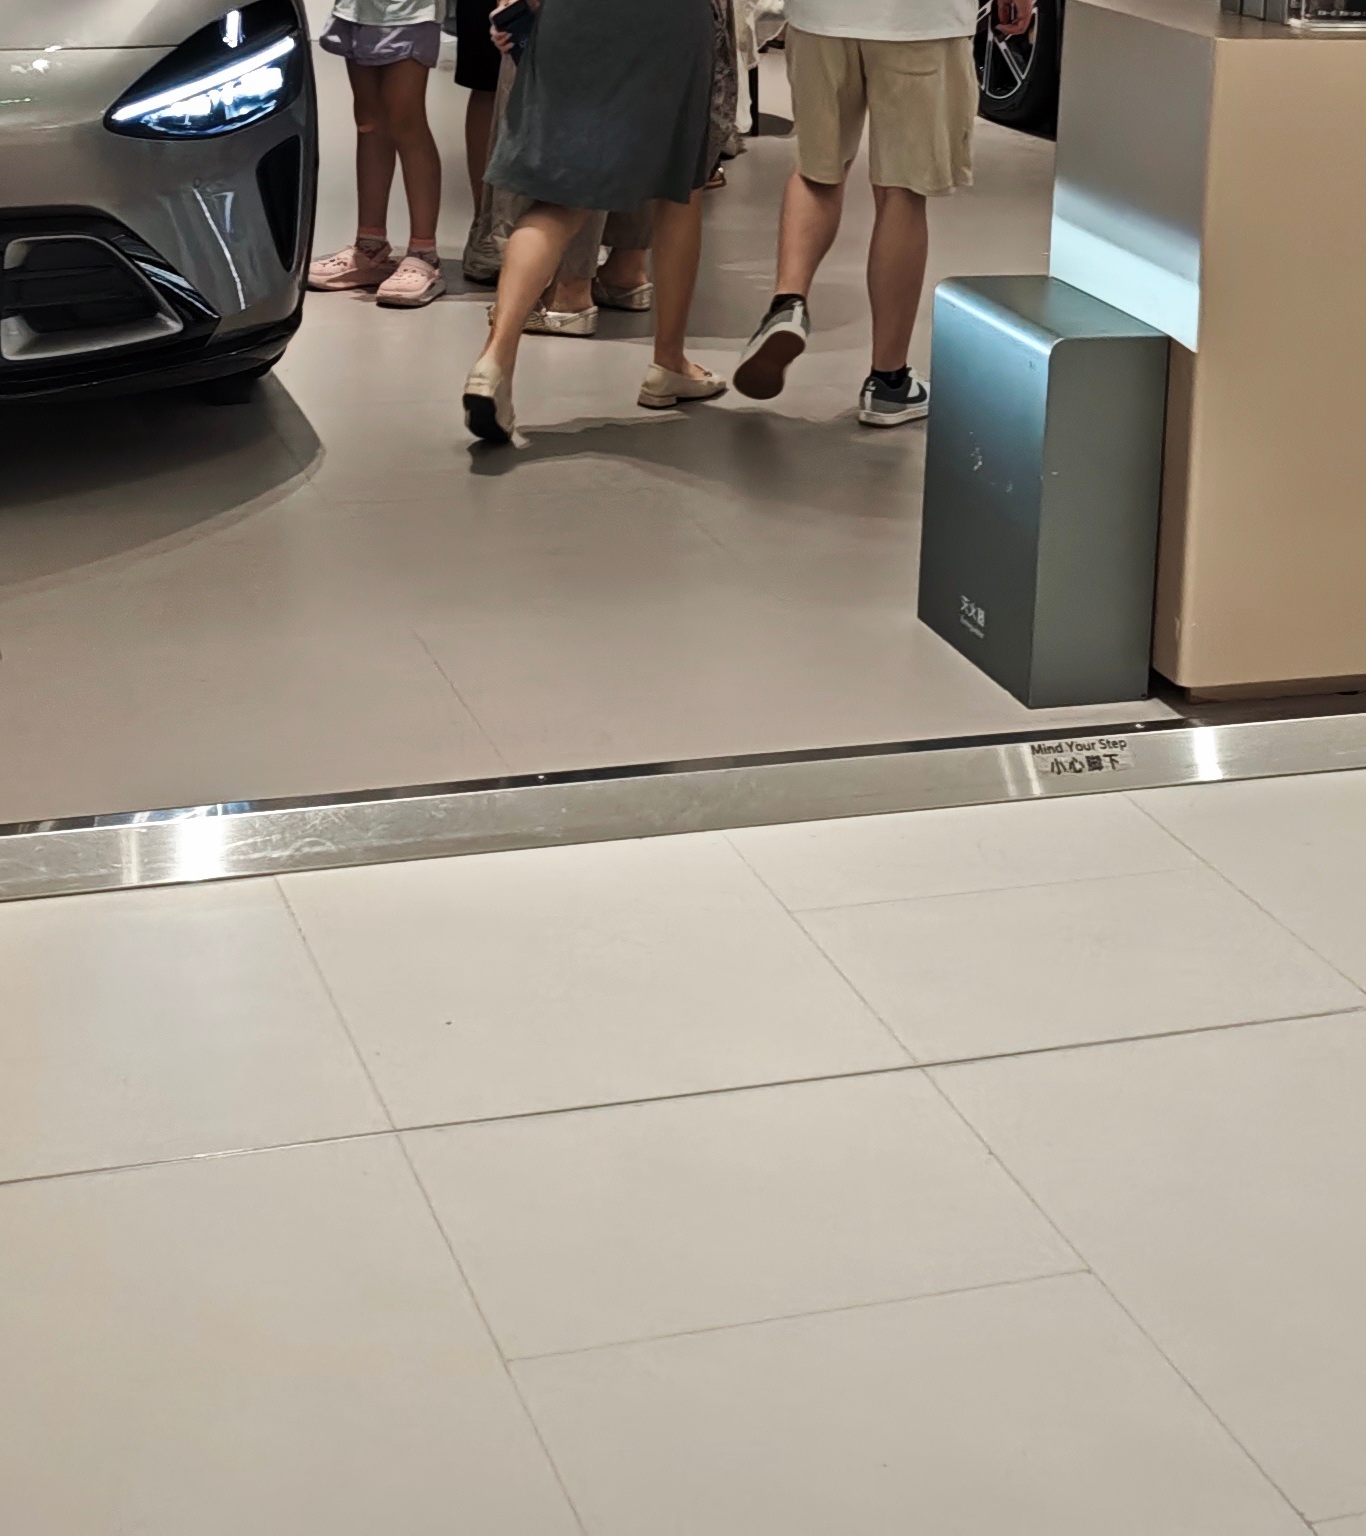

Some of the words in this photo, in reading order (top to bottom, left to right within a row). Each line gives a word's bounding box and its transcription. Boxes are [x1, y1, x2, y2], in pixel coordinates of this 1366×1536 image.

[1031, 744, 1064, 755] Mind
[1065, 741, 1096, 752] Your
[1098, 739, 1128, 751] Step
